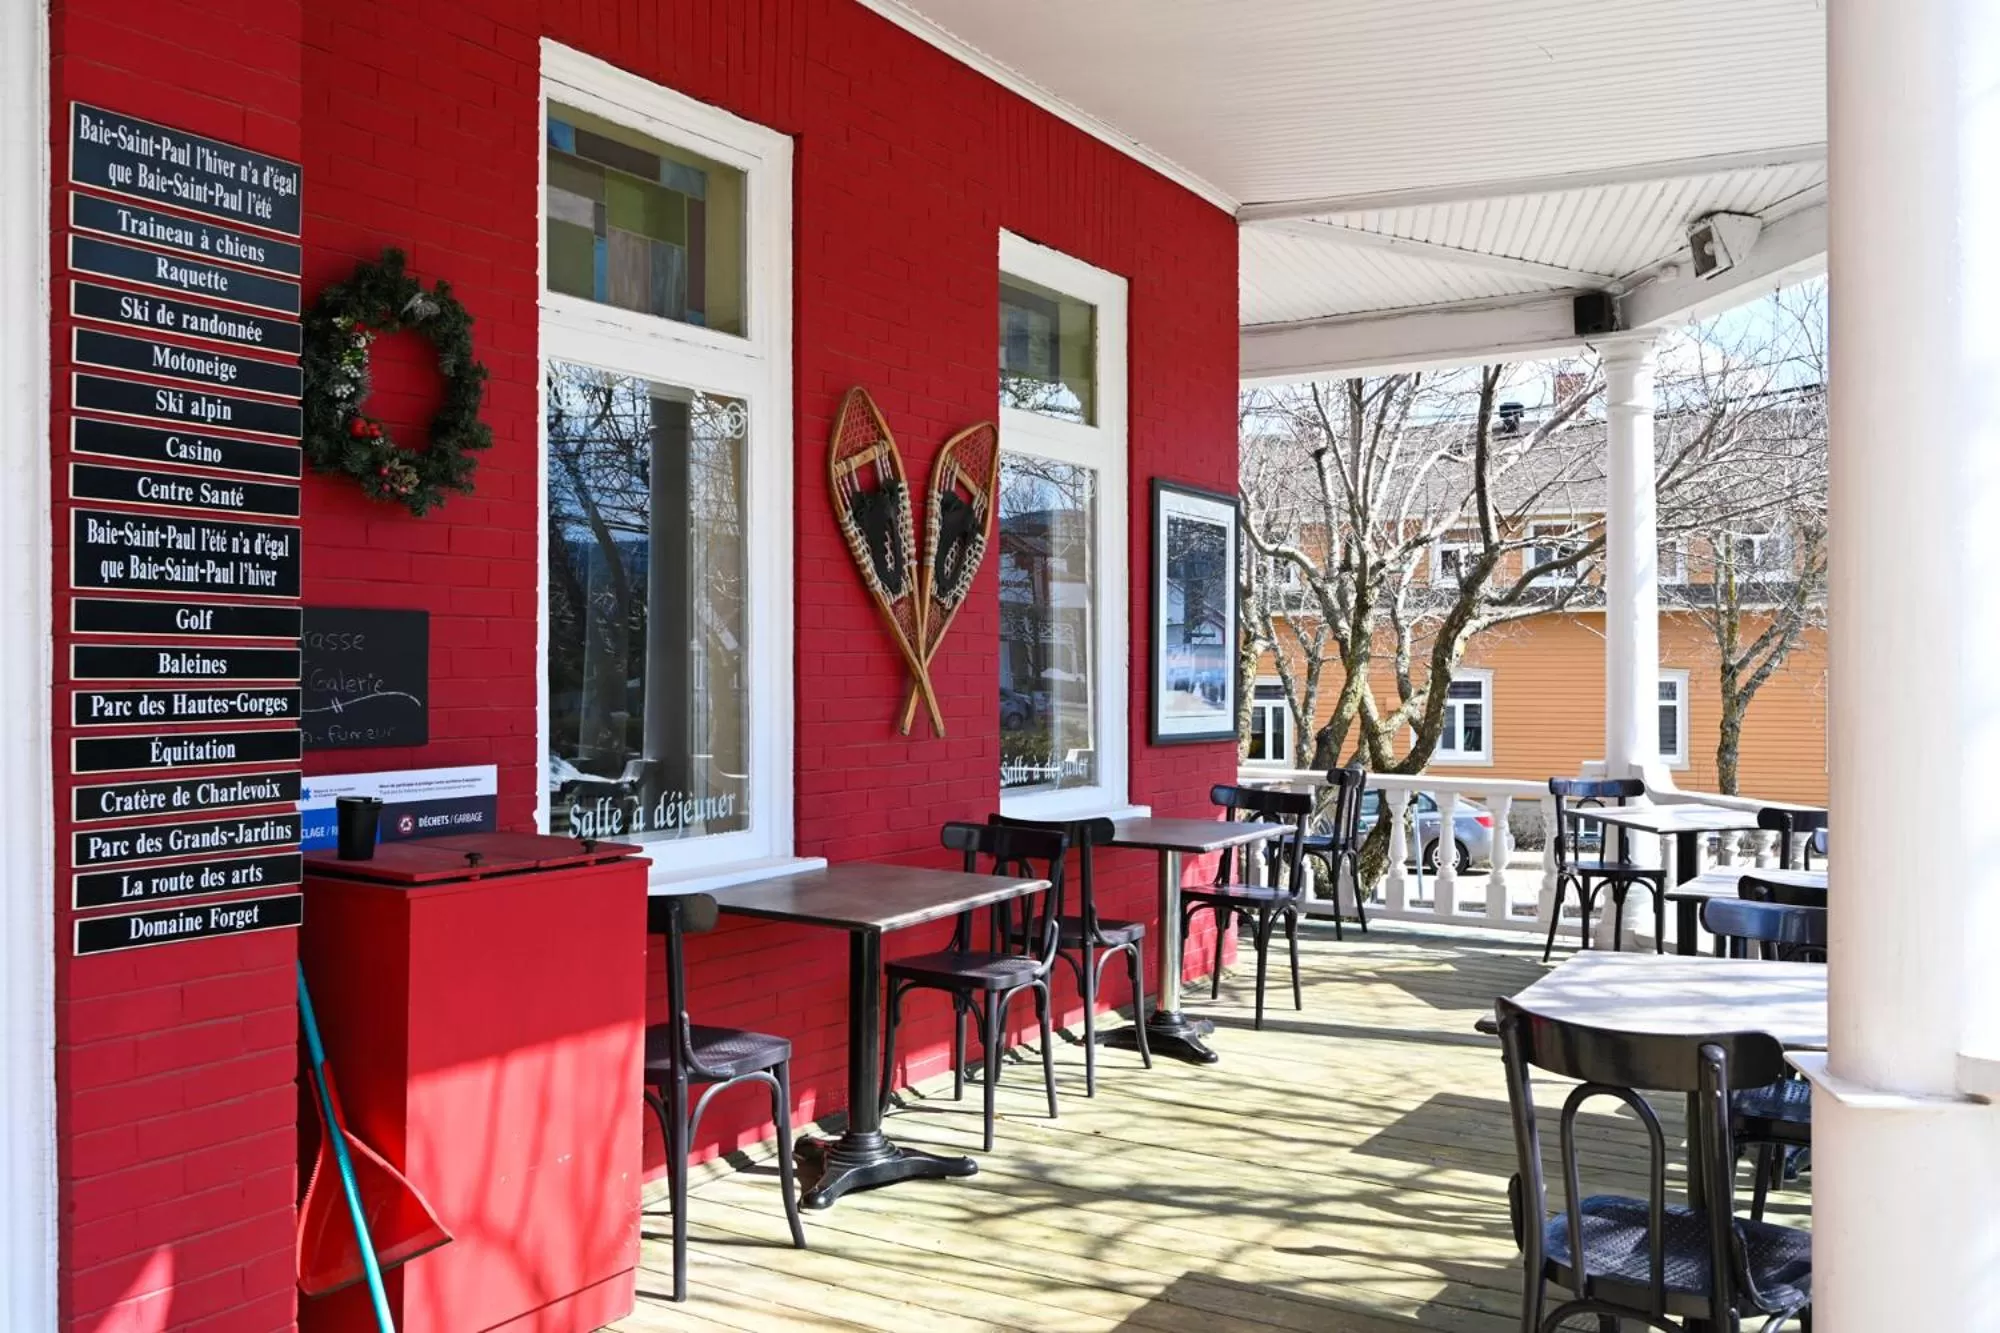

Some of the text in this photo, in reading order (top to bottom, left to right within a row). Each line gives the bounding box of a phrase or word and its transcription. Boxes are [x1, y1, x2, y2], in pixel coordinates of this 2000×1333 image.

[79, 114, 298, 197] Baie-Saint-Paul l'hiver n'a d'égal
[108, 162, 272, 219] que Baie-Saint-Paul l'été
[117, 209, 265, 263] Traineau à chiens
[156, 257, 228, 291] Raquette
[120, 296, 262, 342] Ski de randonnée
[152, 345, 237, 382] Motoneige
[156, 390, 231, 422] Ski alpin
[166, 436, 222, 463] Casino
[137, 477, 244, 507] Centre Santé
[87, 518, 289, 560] Baie-Saint-Paul l'été n'a d'égal
[101, 555, 277, 586] que Baie-Saint-Paul l'hiver
[176, 609, 213, 630] Golf
[158, 653, 227, 674] Baleines
[310, 668, 385, 694] Galerie
[91, 693, 288, 717] Parc des Hautes-Gorges
[150, 737, 236, 766] Équitation
[101, 778, 280, 813] Cratère de Charlevoix
[418, 814, 449, 828] DÉCHETS
[454, 811, 483, 824] GARBAGE
[568, 790, 737, 841] Salle à déjeuner
[89, 823, 293, 859] Parc des Grands-Jardins
[122, 864, 263, 897] La route des arts
[130, 905, 259, 939] Domaine Forget
